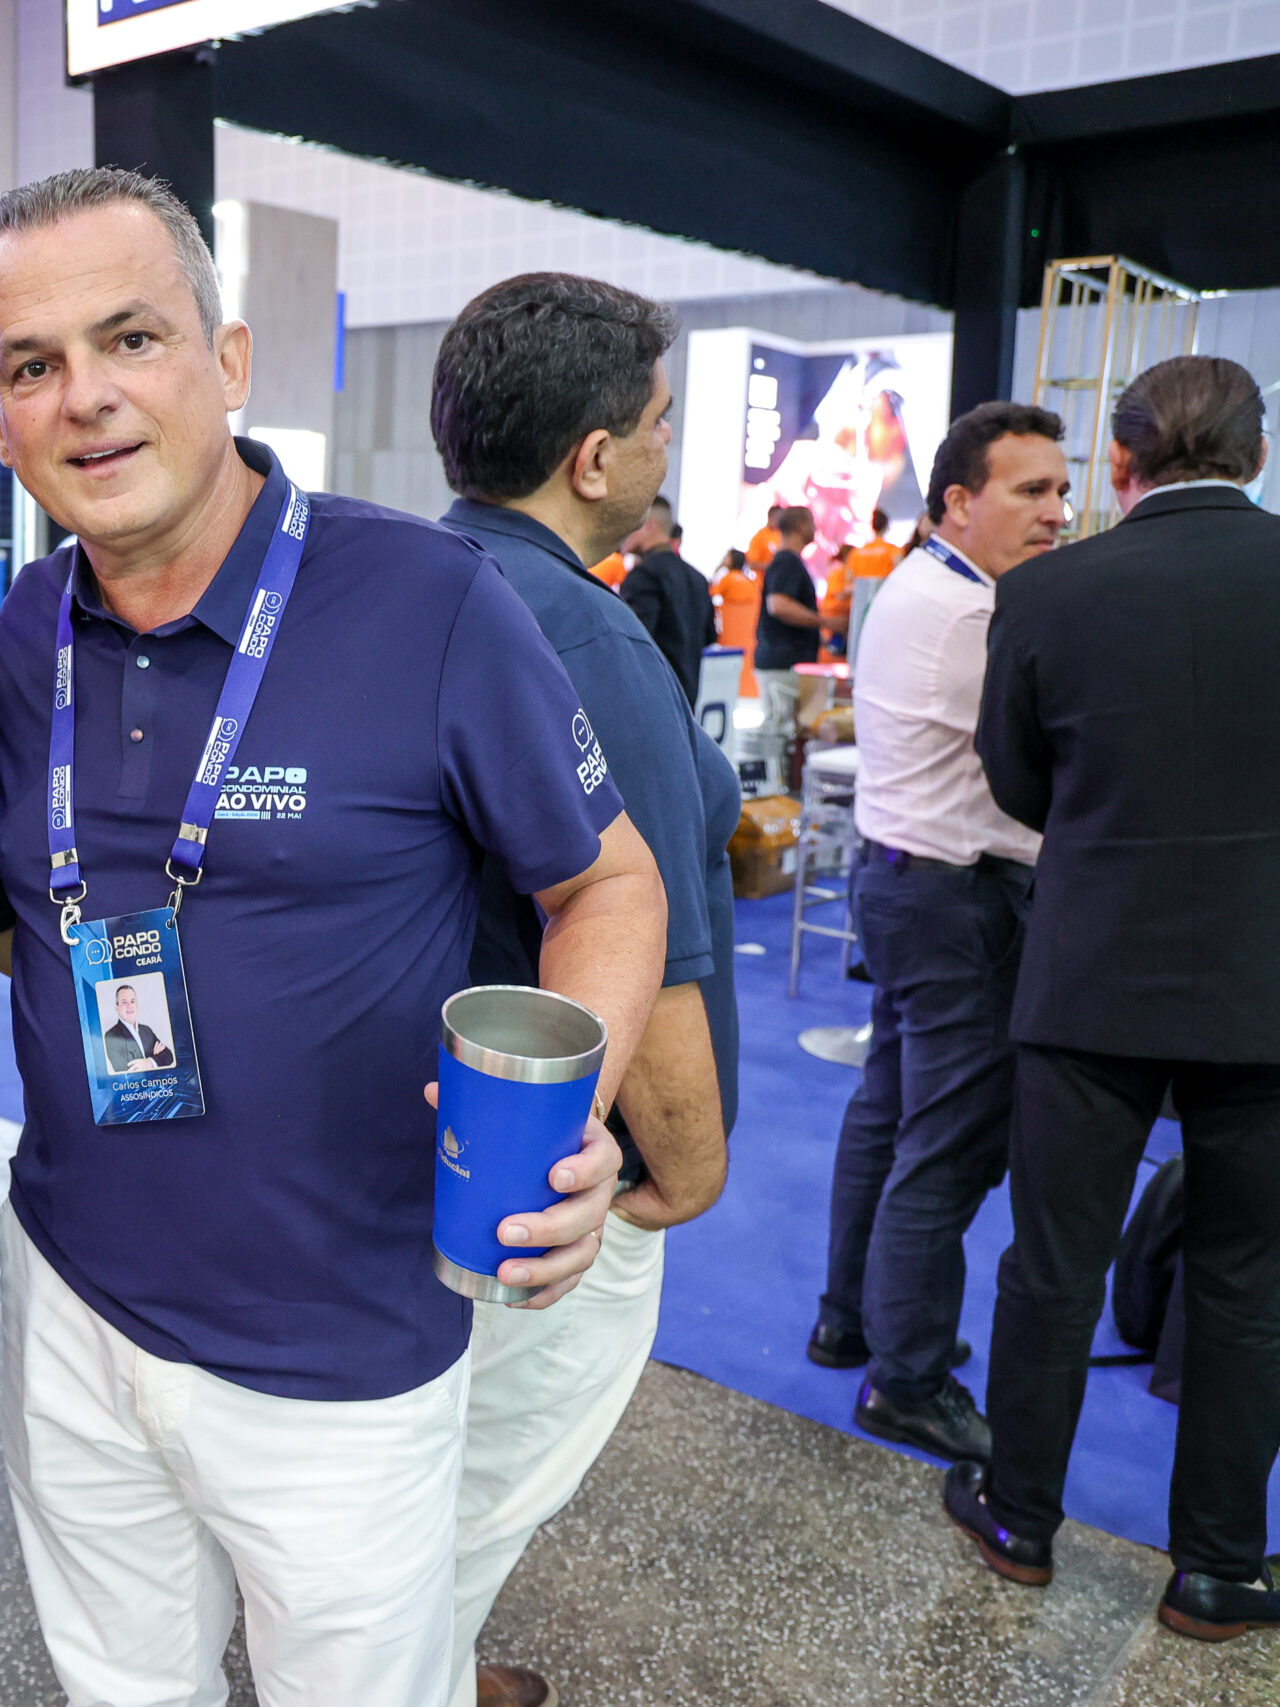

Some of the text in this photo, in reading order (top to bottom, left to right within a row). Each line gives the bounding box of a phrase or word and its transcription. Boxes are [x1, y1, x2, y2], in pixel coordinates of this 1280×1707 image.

[288, 502, 301, 537] CONDO
[294, 504, 309, 541] PAPO
[247, 613, 267, 656] CONDO
[254, 615, 276, 659] PAPO
[56, 648, 64, 689] PAPO
[202, 741, 222, 785] CONDO
[209, 742, 230, 786] PAPO
[576, 737, 602, 784] PAP
[583, 756, 607, 795] COND
[52, 767, 60, 808] PAPO
[215, 793, 307, 811] AO VIVO
[287, 812, 302, 820] MAI
[113, 929, 160, 948] PAPO
[115, 942, 162, 959] CONDO
[136, 953, 163, 967] CEARÁ
[112, 1075, 178, 1091] Carlos Campos
